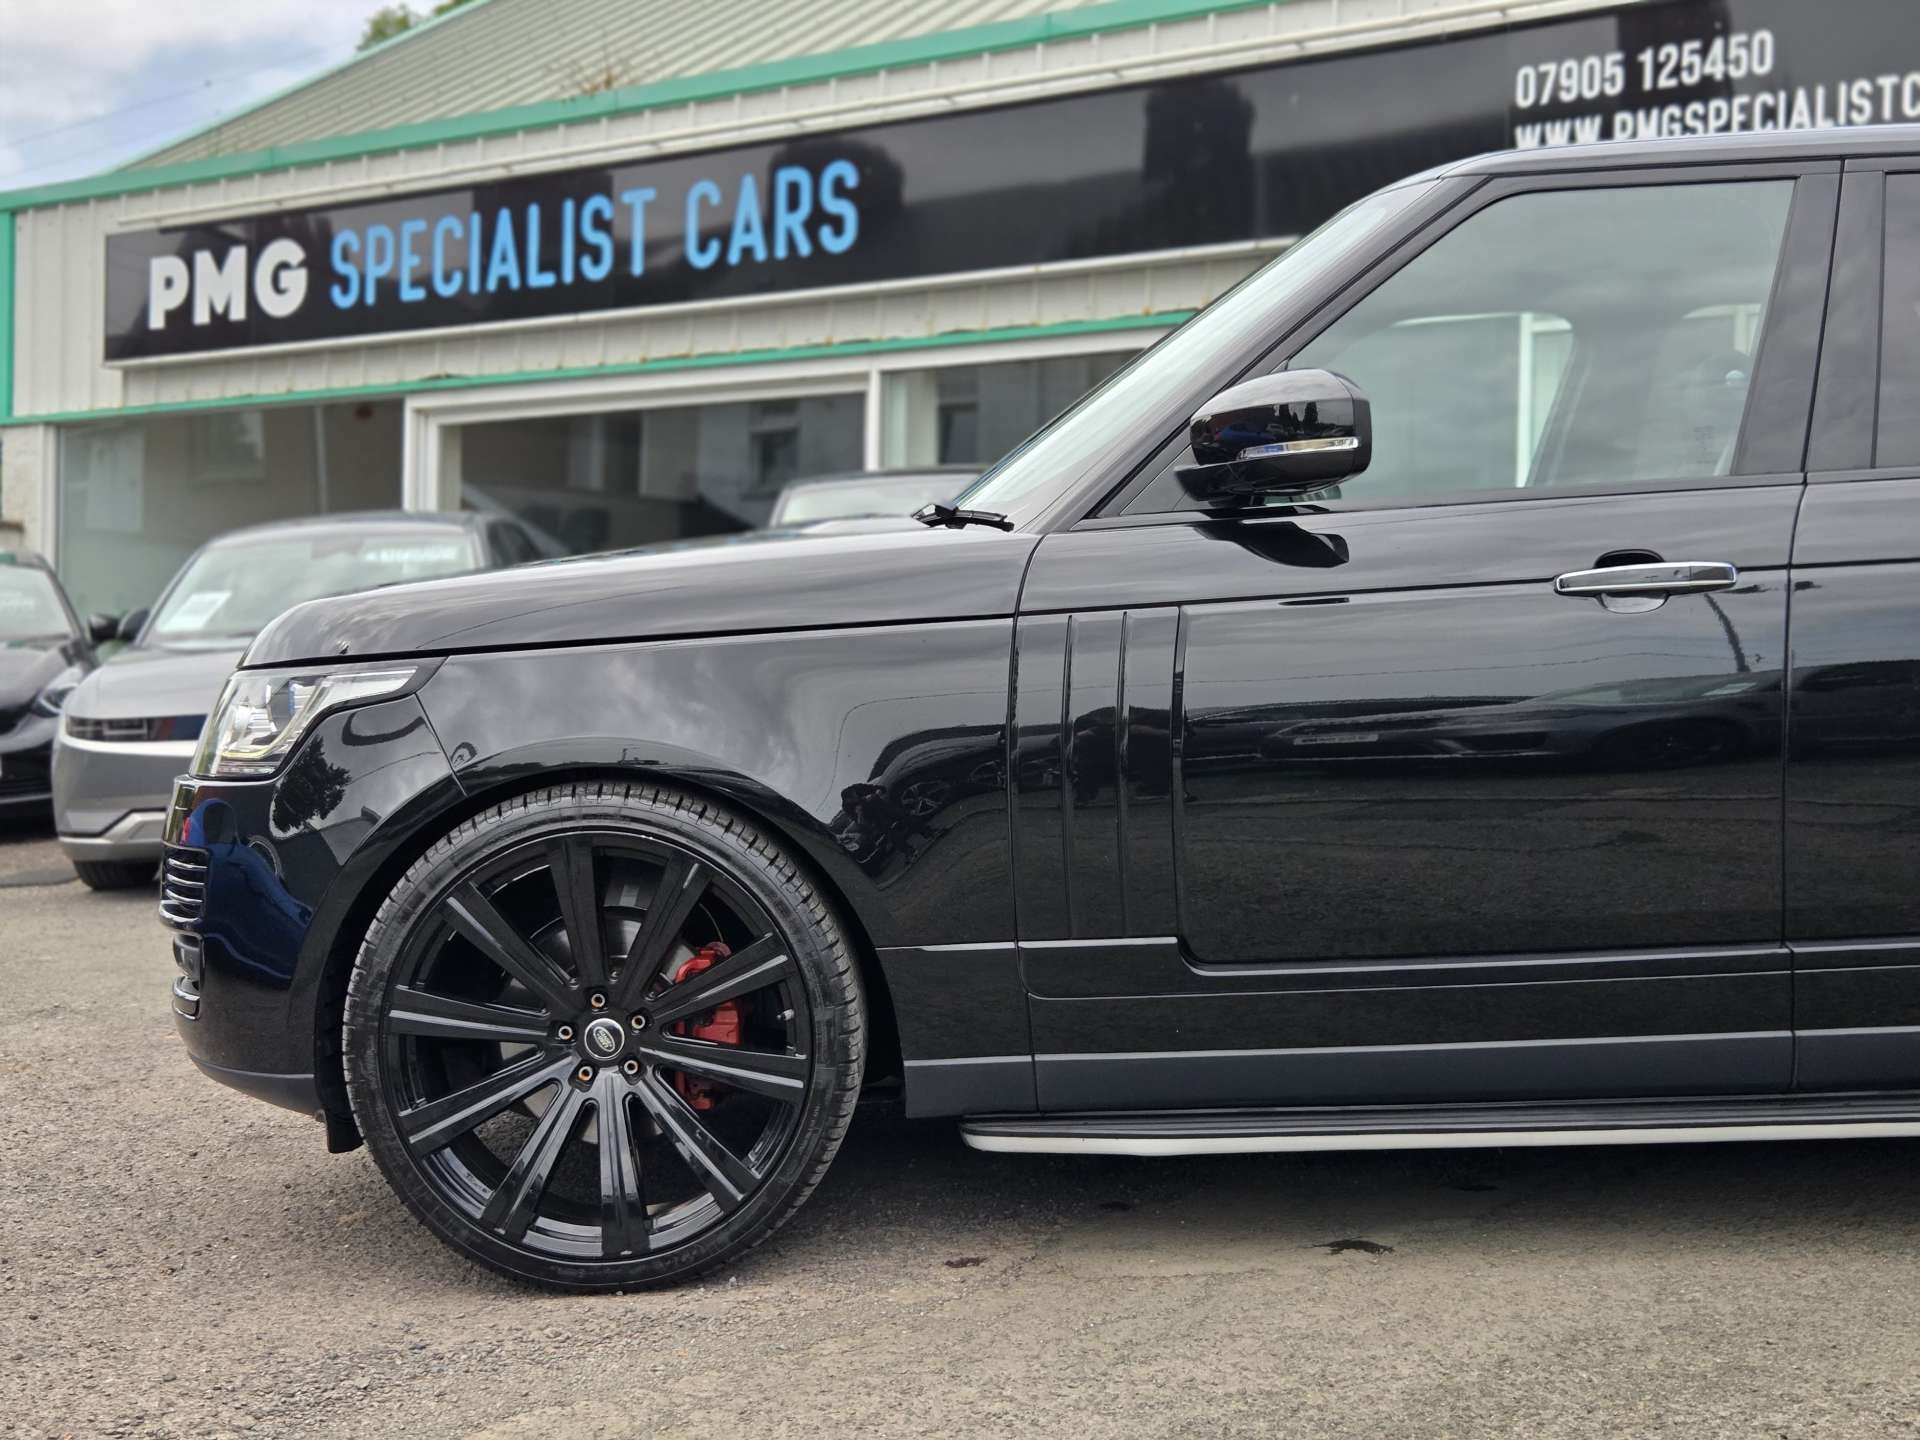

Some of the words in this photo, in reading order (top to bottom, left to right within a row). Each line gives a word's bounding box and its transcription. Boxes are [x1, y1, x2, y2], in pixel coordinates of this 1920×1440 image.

[1515, 52, 1625, 108] 07905
[1638, 30, 1774, 92] 125450
[147, 239, 307, 330] PMG
[330, 188, 656, 309] SPECIALIST
[685, 159, 859, 269] CARS
